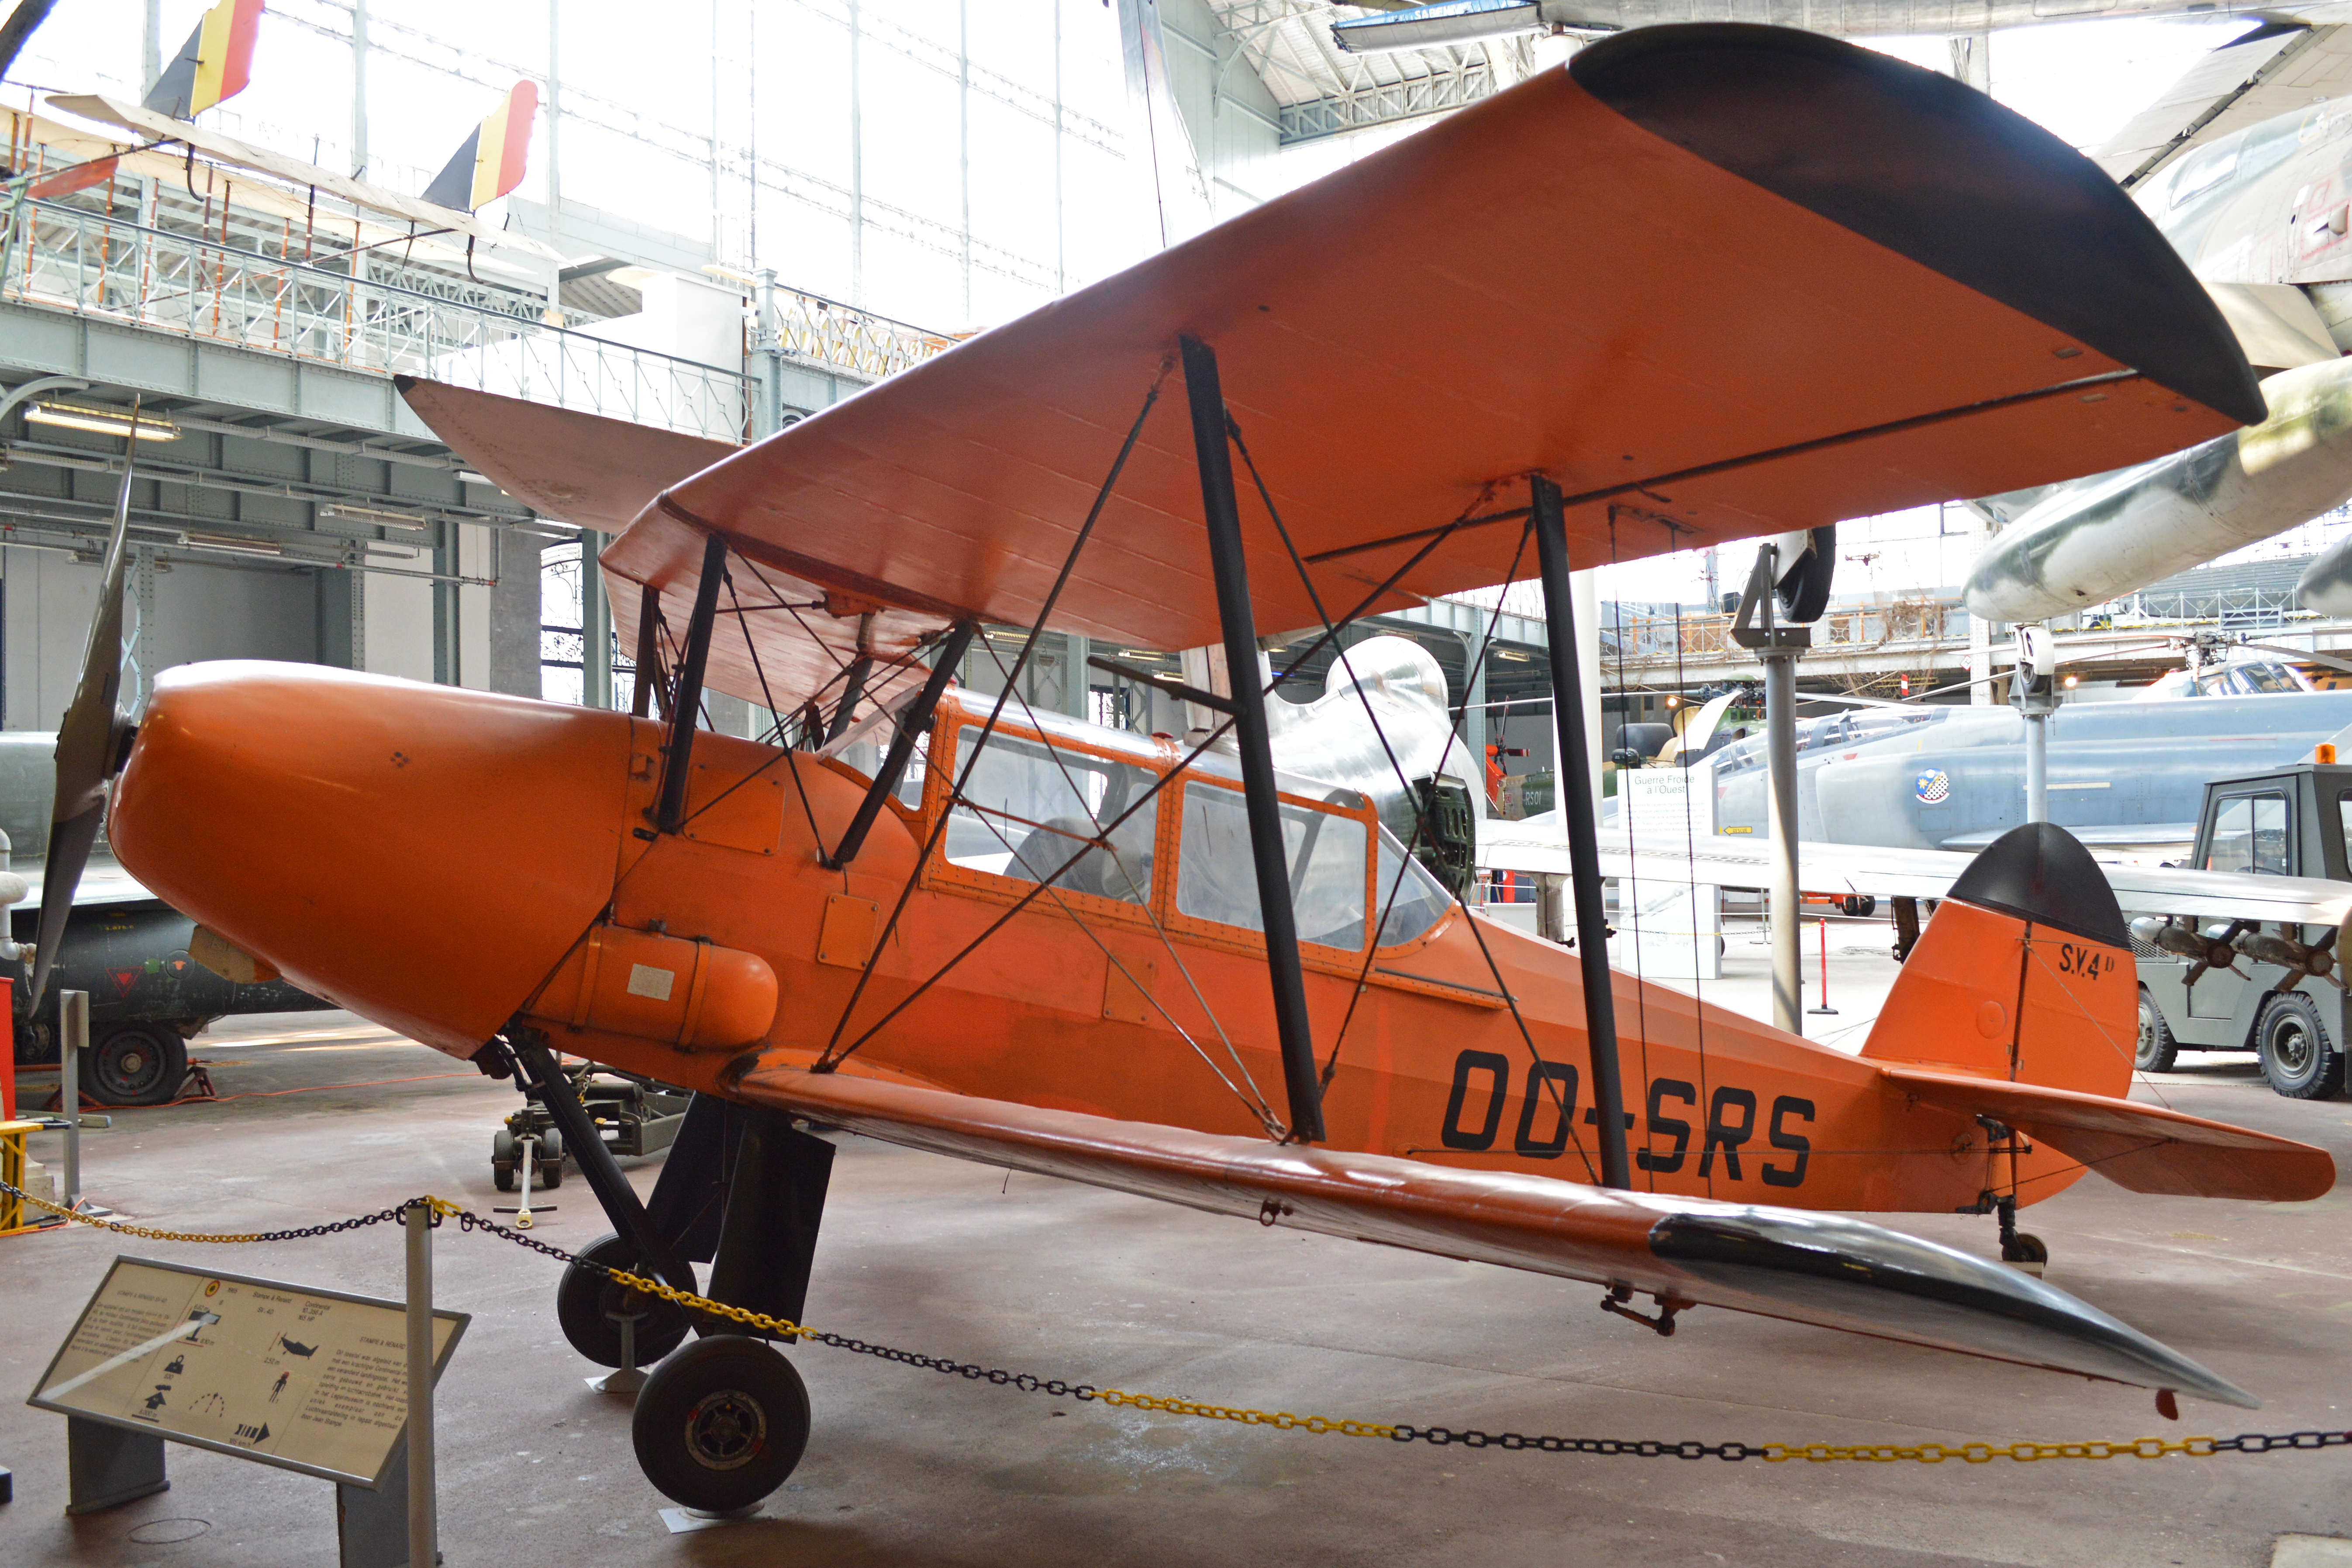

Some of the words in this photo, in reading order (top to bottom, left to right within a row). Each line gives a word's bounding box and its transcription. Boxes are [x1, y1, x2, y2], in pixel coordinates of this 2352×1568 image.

[1635, 776, 1664, 785] Guerre
[1655, 785, 1685, 793] l'Ouest
[1441, 1049, 1815, 1188] OO-SRS
